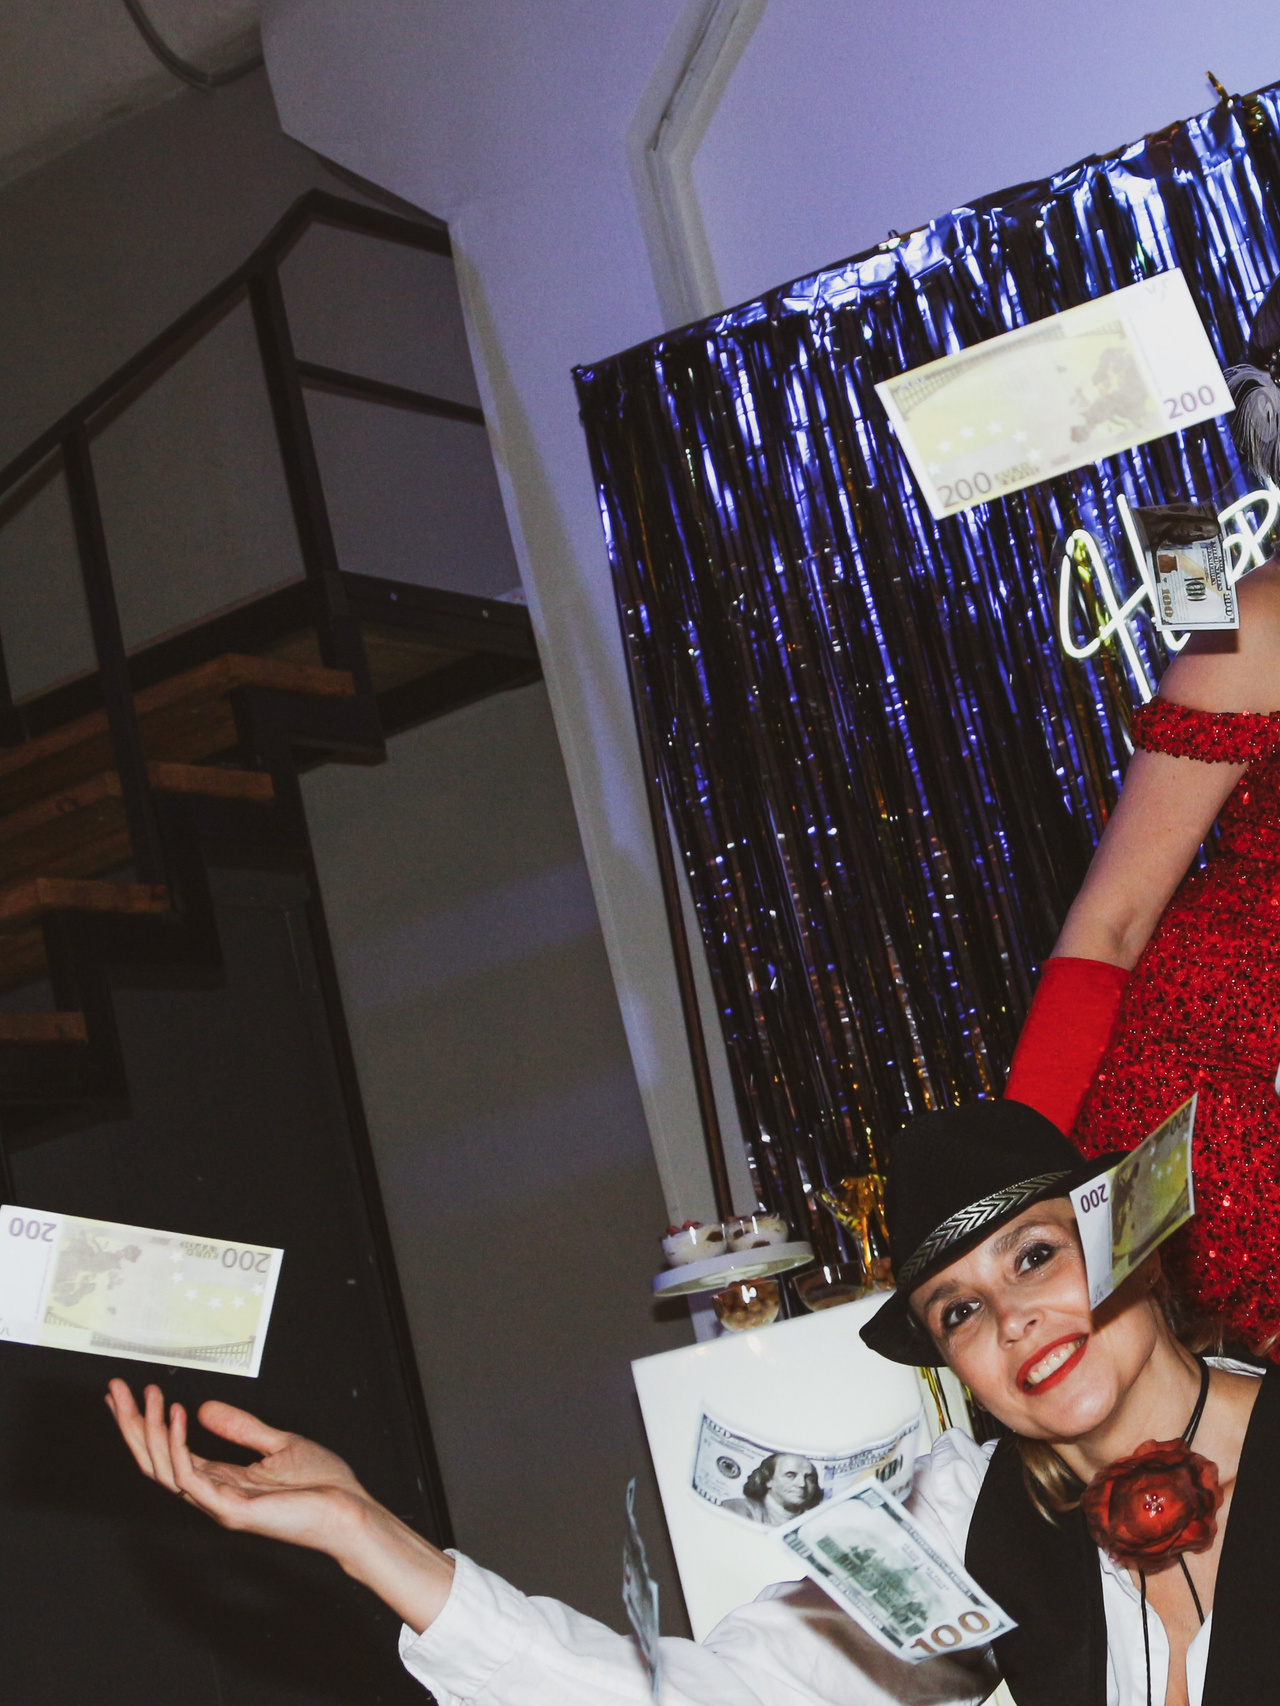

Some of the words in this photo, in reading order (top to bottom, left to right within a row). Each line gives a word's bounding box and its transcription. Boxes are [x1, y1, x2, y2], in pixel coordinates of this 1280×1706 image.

[1163, 385, 1215, 420] 200
[937, 471, 992, 509] 200
[1080, 1183, 1109, 1214] 200
[8, 1216, 57, 1243] 200
[221, 1247, 272, 1274] 200
[909, 1610, 991, 1655] 100
